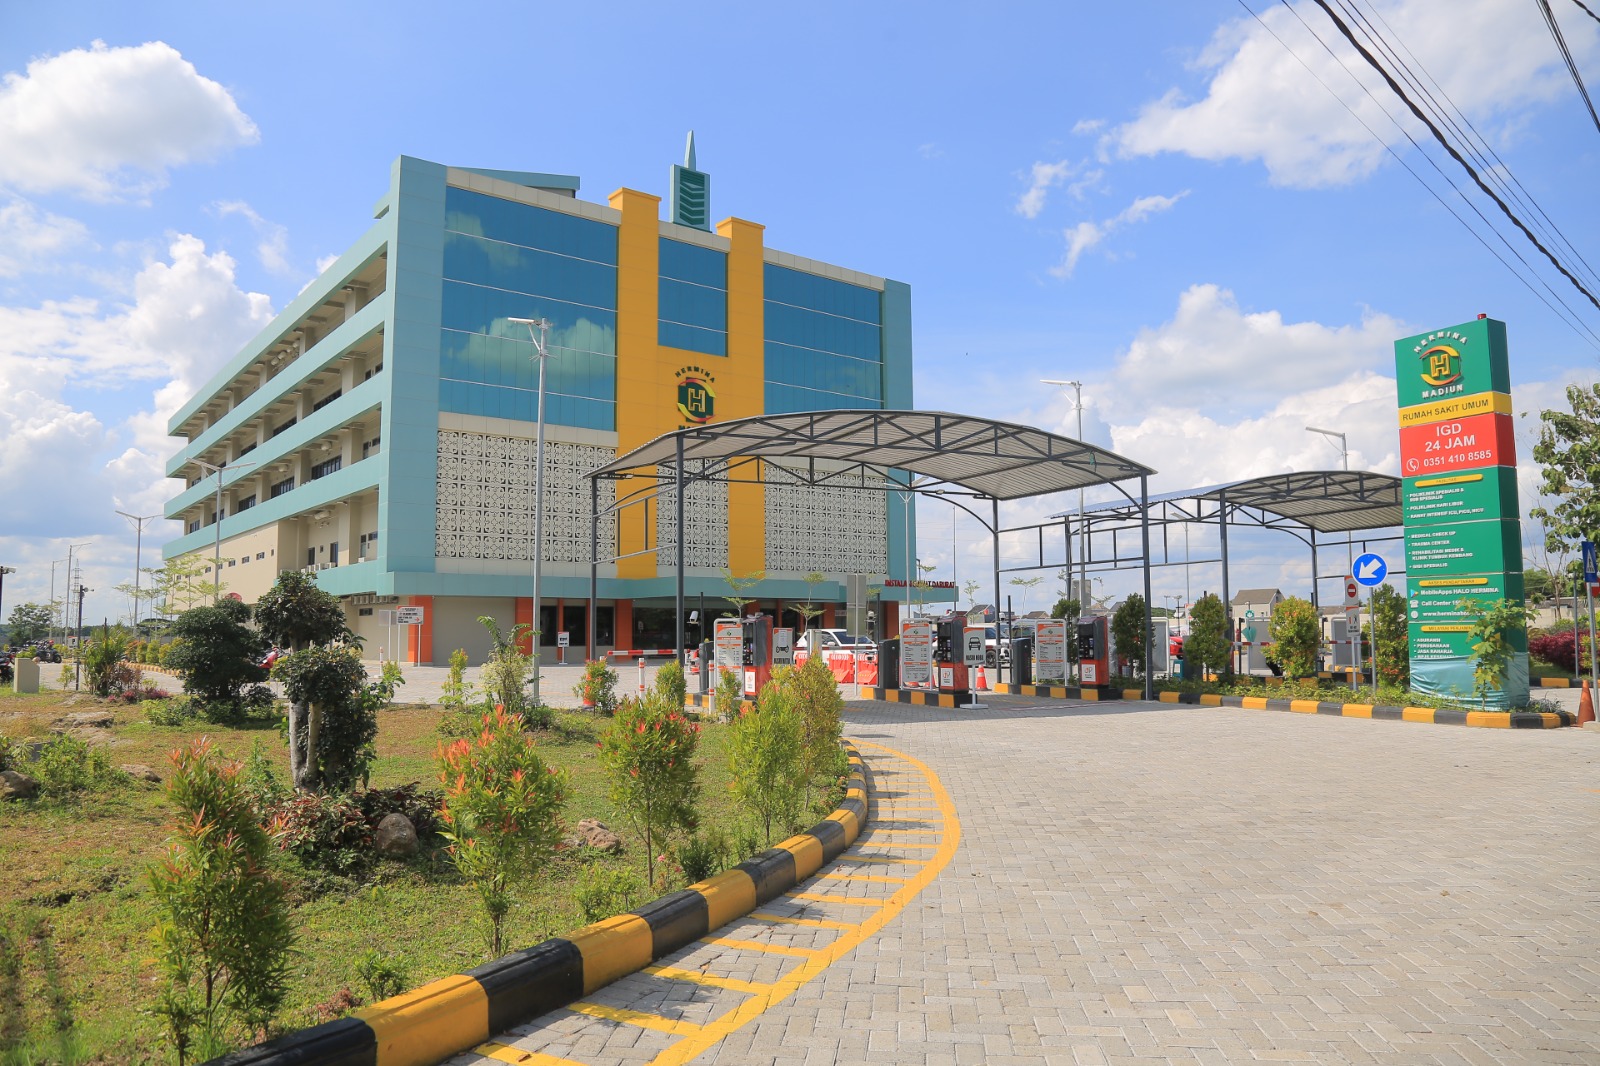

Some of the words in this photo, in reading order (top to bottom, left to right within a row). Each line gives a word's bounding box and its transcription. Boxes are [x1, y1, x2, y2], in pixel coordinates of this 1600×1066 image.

[1414, 332, 1467, 353] HERMINA
[675, 366, 715, 383] HERMINA
[1430, 354, 1450, 377] H
[1422, 384, 1463, 398] MADIUN
[688, 388, 706, 413] H
[1403, 410, 1432, 421] RUMAH
[1435, 405, 1459, 415] SAKIT
[1462, 399, 1488, 410] UMUM
[1436, 423, 1462, 437] IGD
[1425, 440, 1441, 452] 24
[1444, 434, 1476, 449] JAM
[1423, 456, 1445, 467] 0351
[1448, 453, 1465, 463] 410
[1468, 449, 1492, 460] 8585
